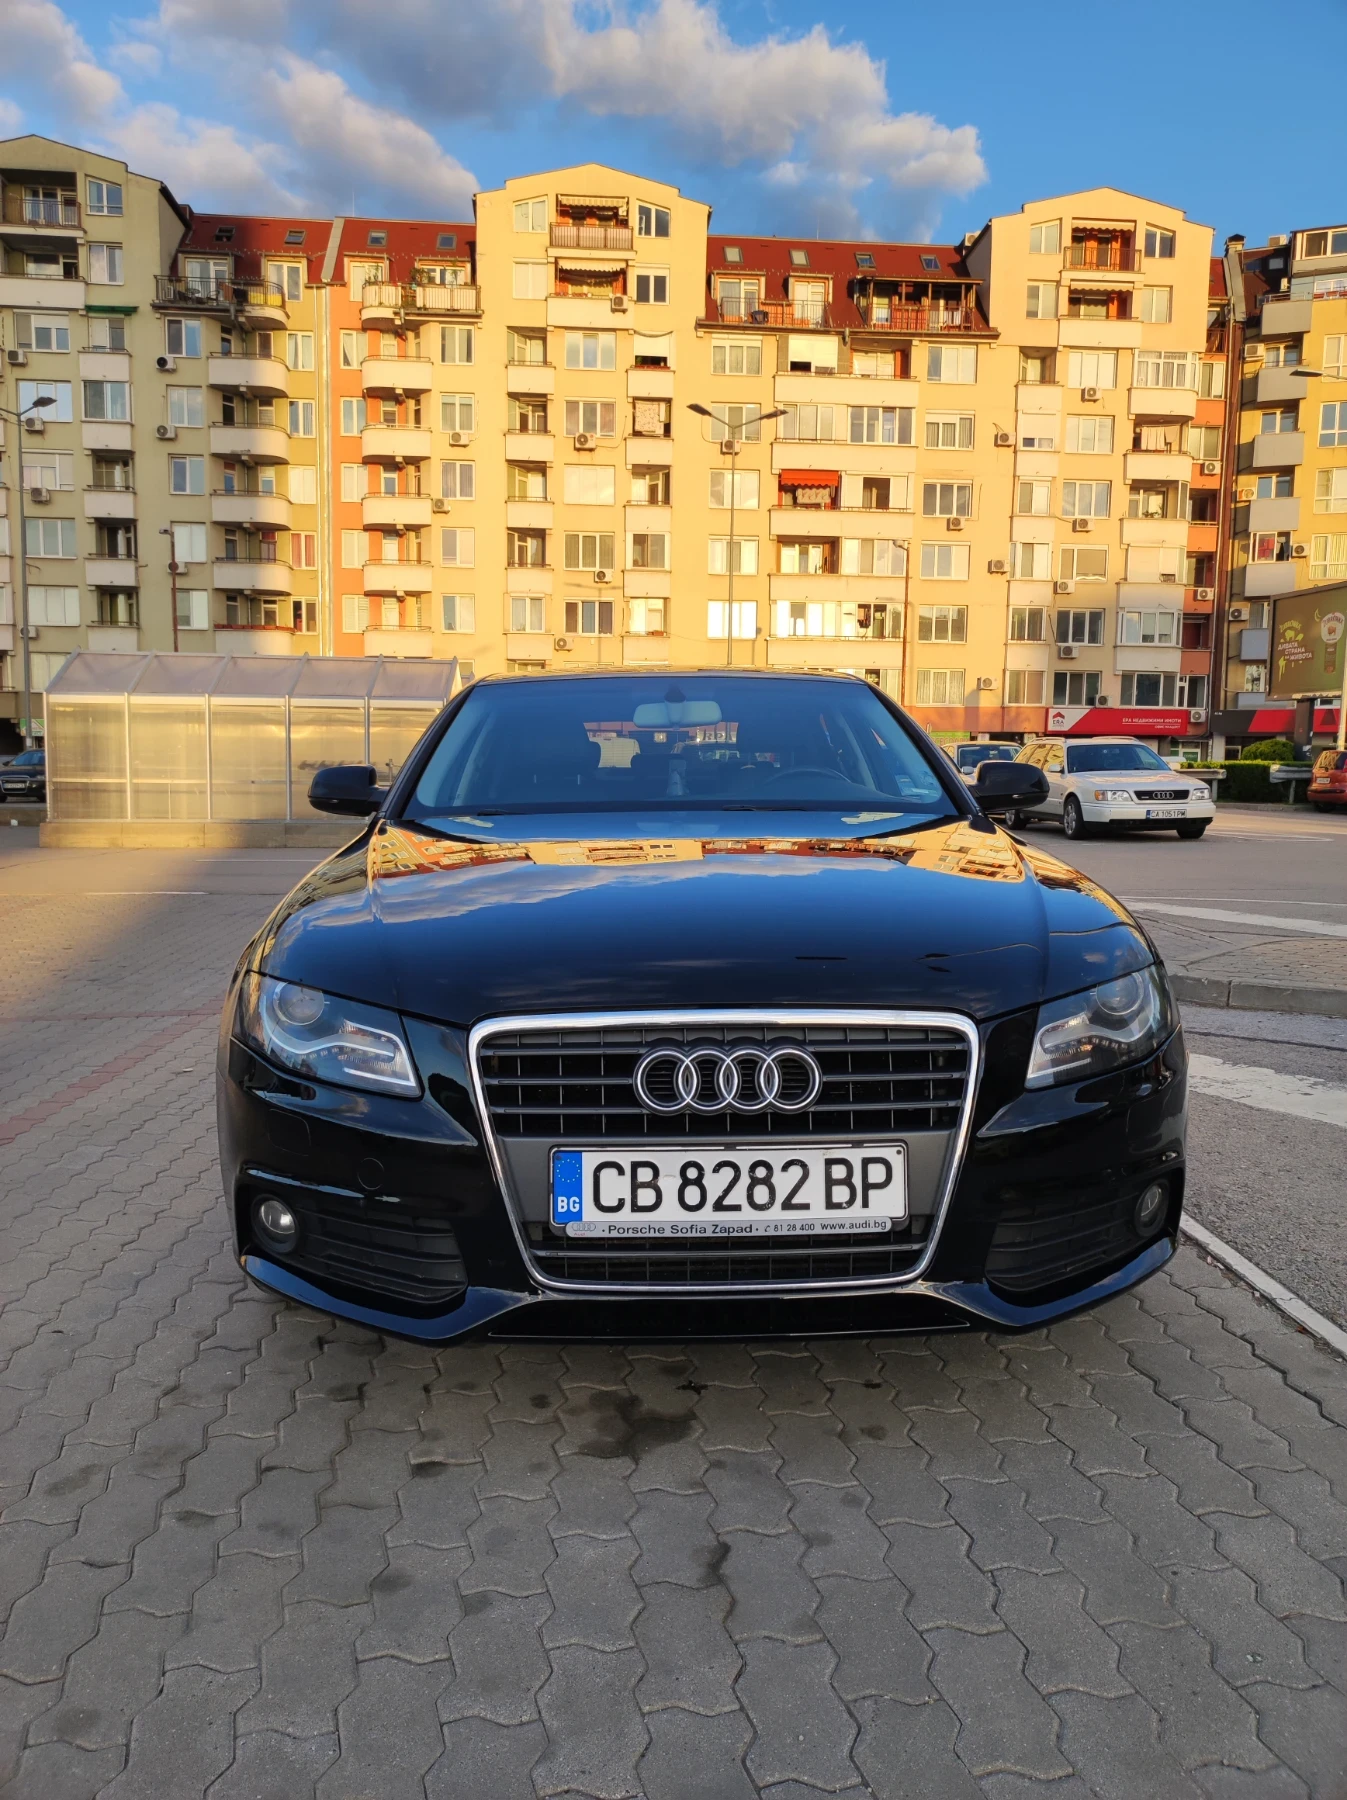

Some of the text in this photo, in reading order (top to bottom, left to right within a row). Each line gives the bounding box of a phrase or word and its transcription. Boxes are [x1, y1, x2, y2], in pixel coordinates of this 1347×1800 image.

[592, 1156, 893, 1213] CB 8282 BP
[558, 1196, 580, 1212] BG
[608, 1219, 887, 1236] Porsche Sofia Zapad 81 28 400 www.audi.bg
